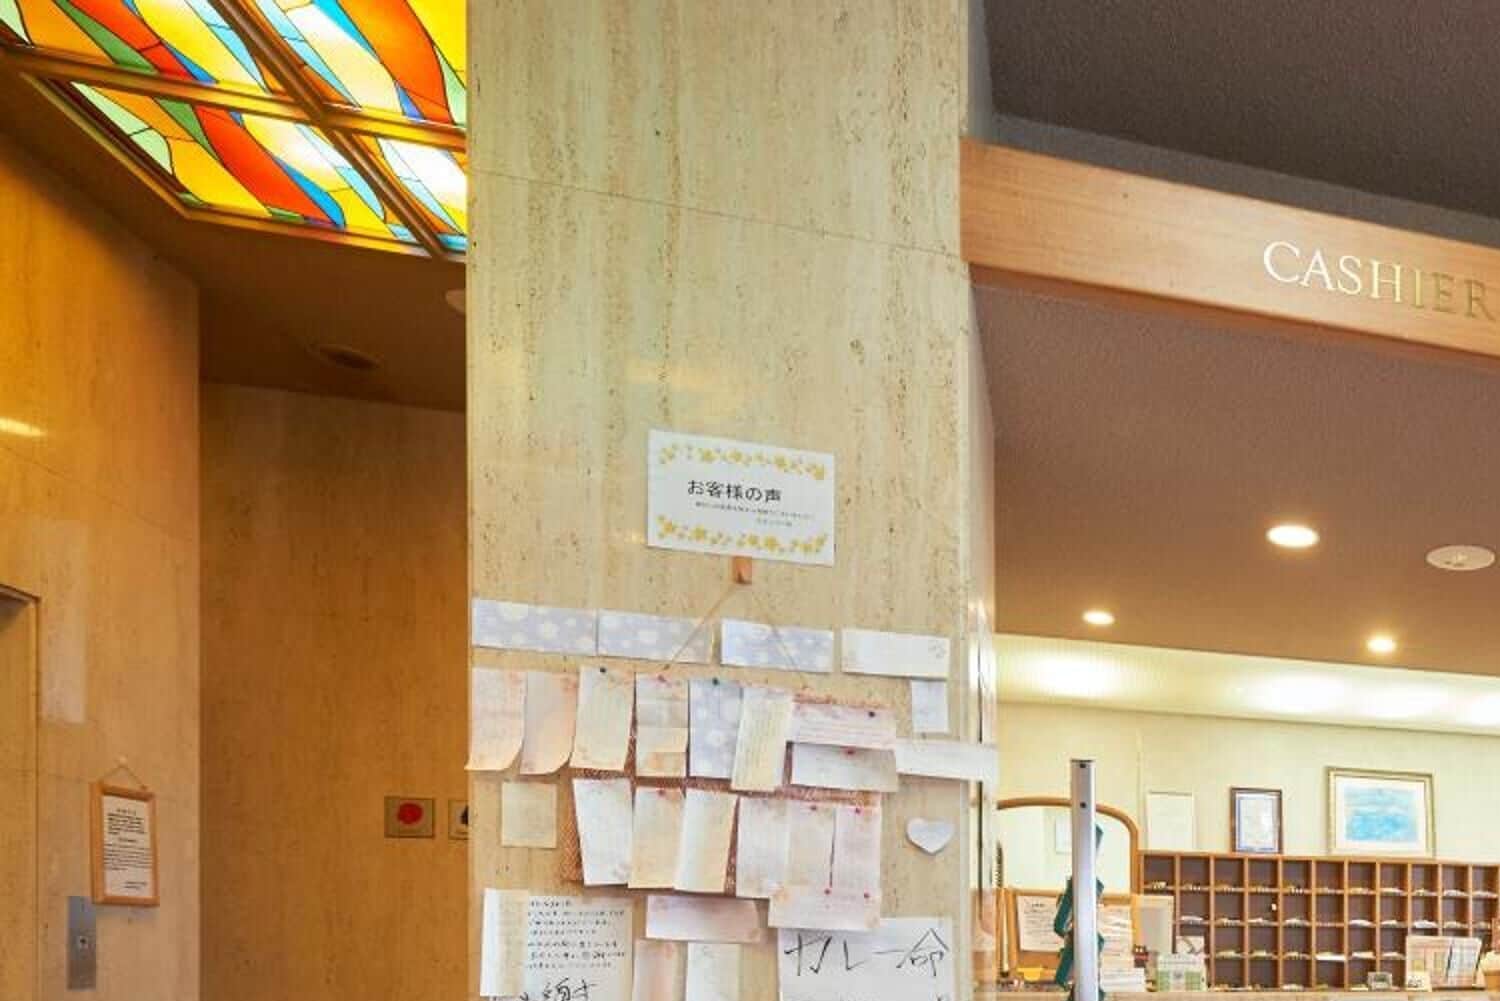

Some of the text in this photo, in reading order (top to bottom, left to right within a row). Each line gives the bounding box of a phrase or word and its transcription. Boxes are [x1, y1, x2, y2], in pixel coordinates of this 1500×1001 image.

[1263, 240, 1497, 321] CASHIER
[687, 479, 783, 503] お客様の声
